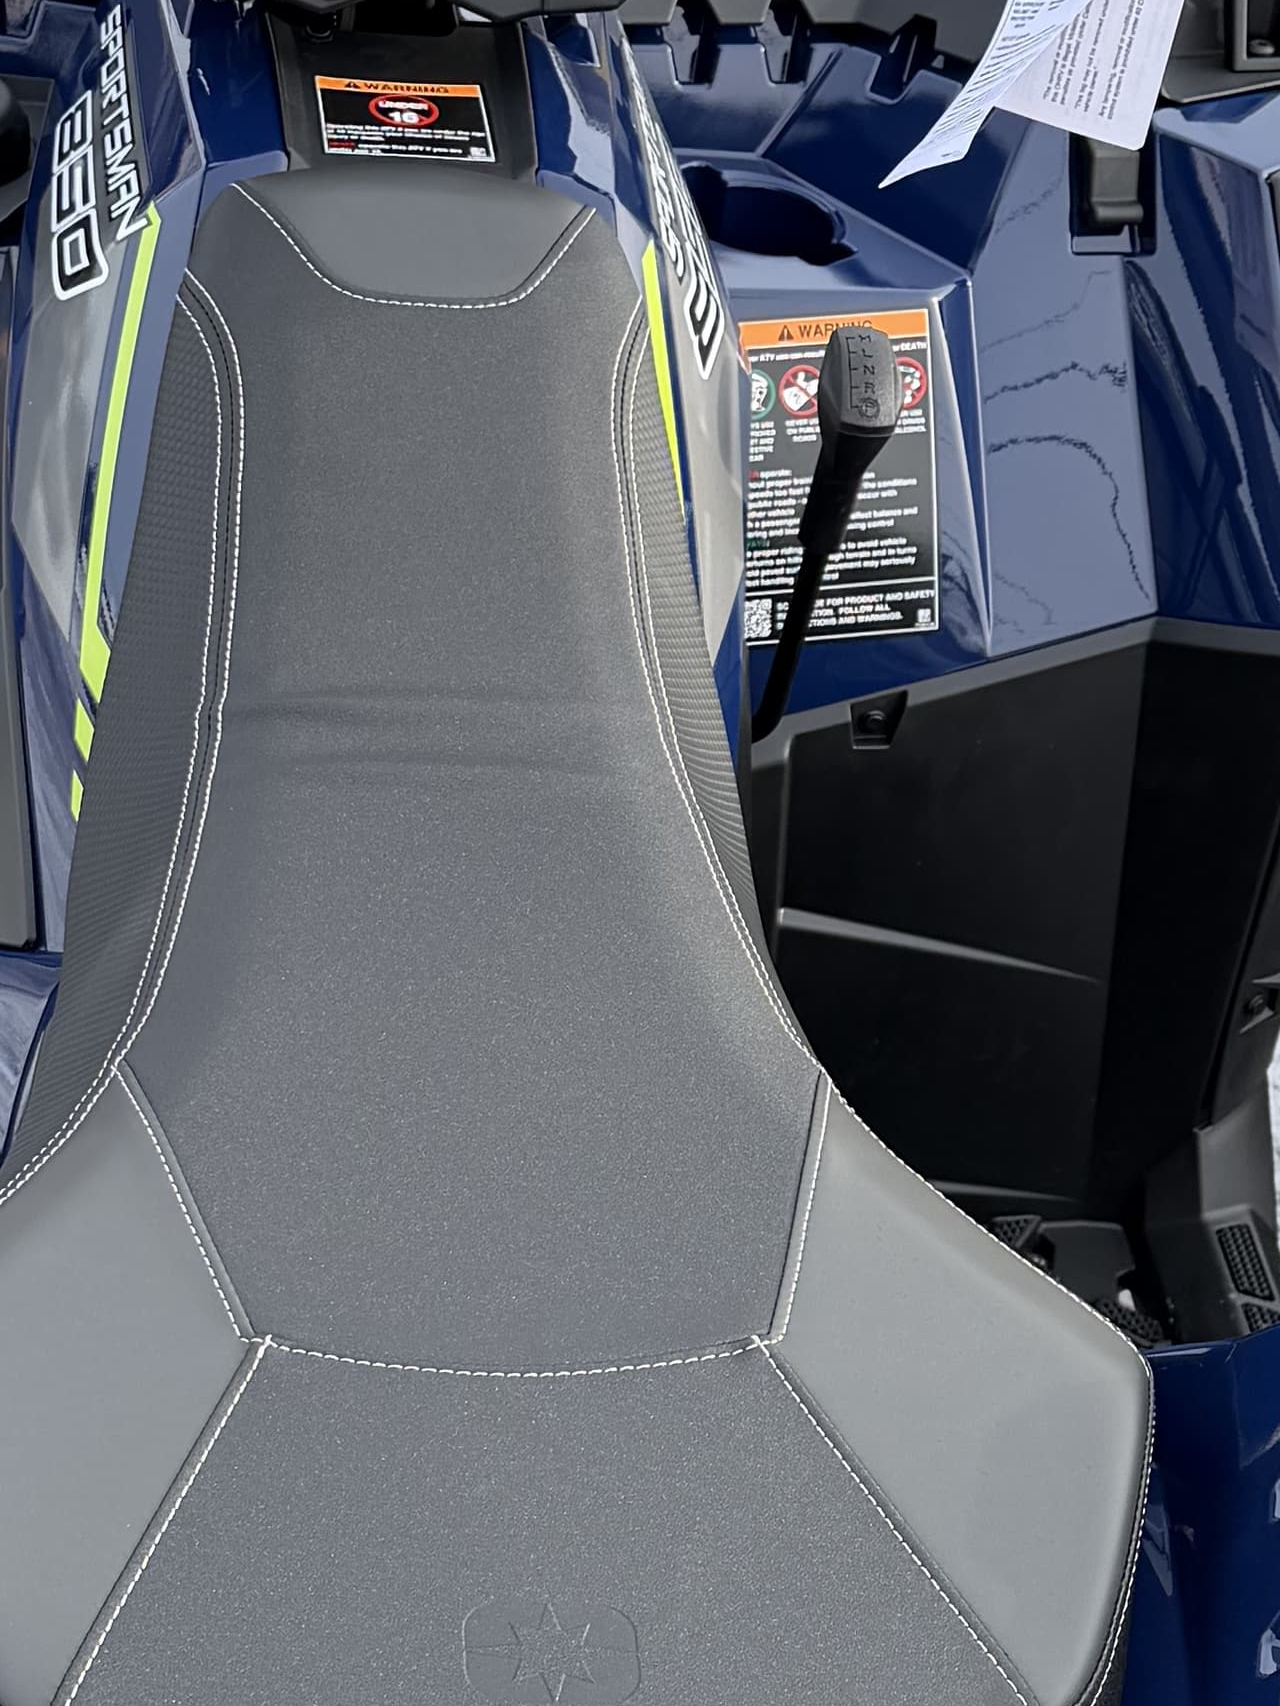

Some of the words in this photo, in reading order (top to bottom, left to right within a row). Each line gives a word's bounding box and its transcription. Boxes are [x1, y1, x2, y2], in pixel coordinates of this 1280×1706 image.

[50, 89, 109, 302] 850
[100, 4, 149, 242] SPORTSMAN
[388, 110, 420, 123] 16
